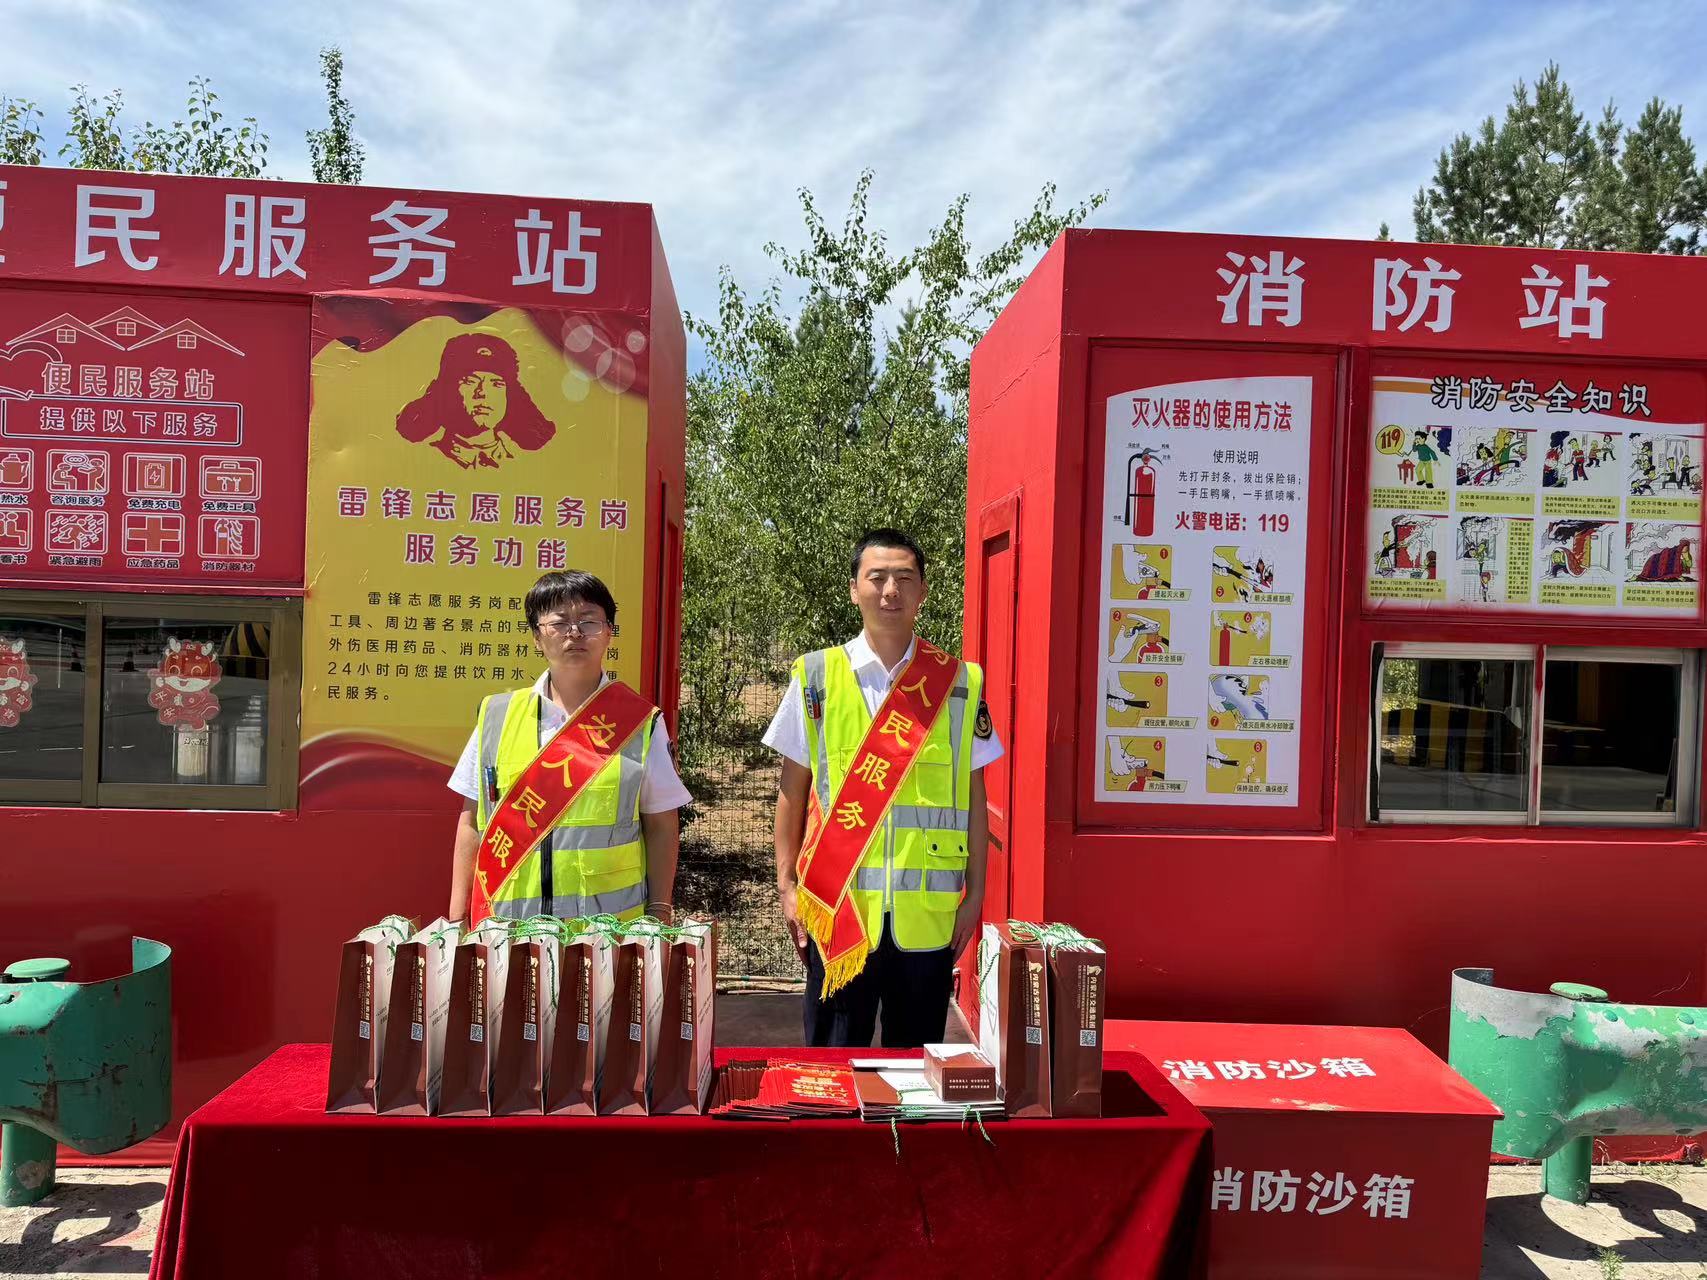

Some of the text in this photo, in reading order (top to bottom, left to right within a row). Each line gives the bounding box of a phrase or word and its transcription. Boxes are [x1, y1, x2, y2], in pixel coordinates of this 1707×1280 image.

[1216, 250, 1610, 339] 消防站
[42, 362, 214, 399] 便民服务站
[1431, 376, 1652, 417] 消防安全知识
[40, 406, 217, 437] 提供以下服务
[1131, 397, 1293, 431] 灭火器的使用方法
[1381, 429, 1402, 449] 119
[1213, 449, 1259, 465] 使用说明
[51, 495, 104, 506] 咨询服务
[127, 499, 181, 510] 免费充电
[202, 501, 256, 512] 免费工具
[337, 486, 629, 530] 雷锋志愿服务岗
[48, 555, 104, 567] 紧急避雨
[404, 533, 567, 569] 服务功能
[127, 558, 180, 569] 应急药品
[202, 561, 255, 572] 消防器材
[327, 685, 390, 702] 民服务。
[1161, 1057, 1377, 1080] 消防沙箱
